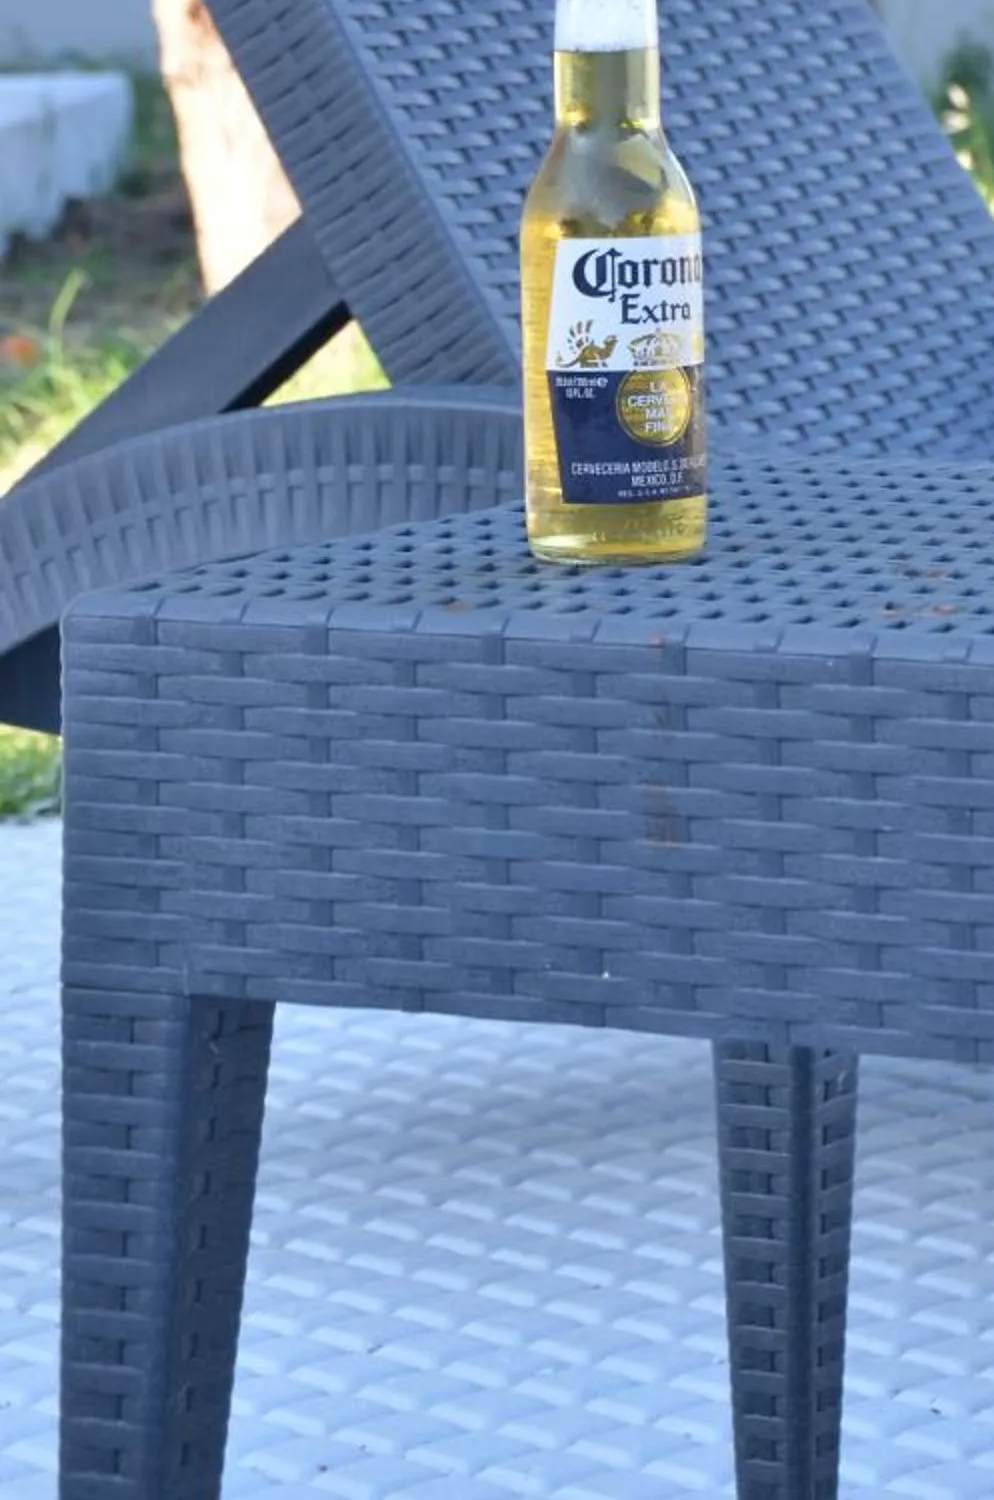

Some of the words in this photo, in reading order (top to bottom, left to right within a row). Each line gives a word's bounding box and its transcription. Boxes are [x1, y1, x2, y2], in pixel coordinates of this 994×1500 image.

[620, 293, 691, 324] Extra
[649, 381, 666, 393] LA
[571, 461, 630, 476] CERVECERIA
